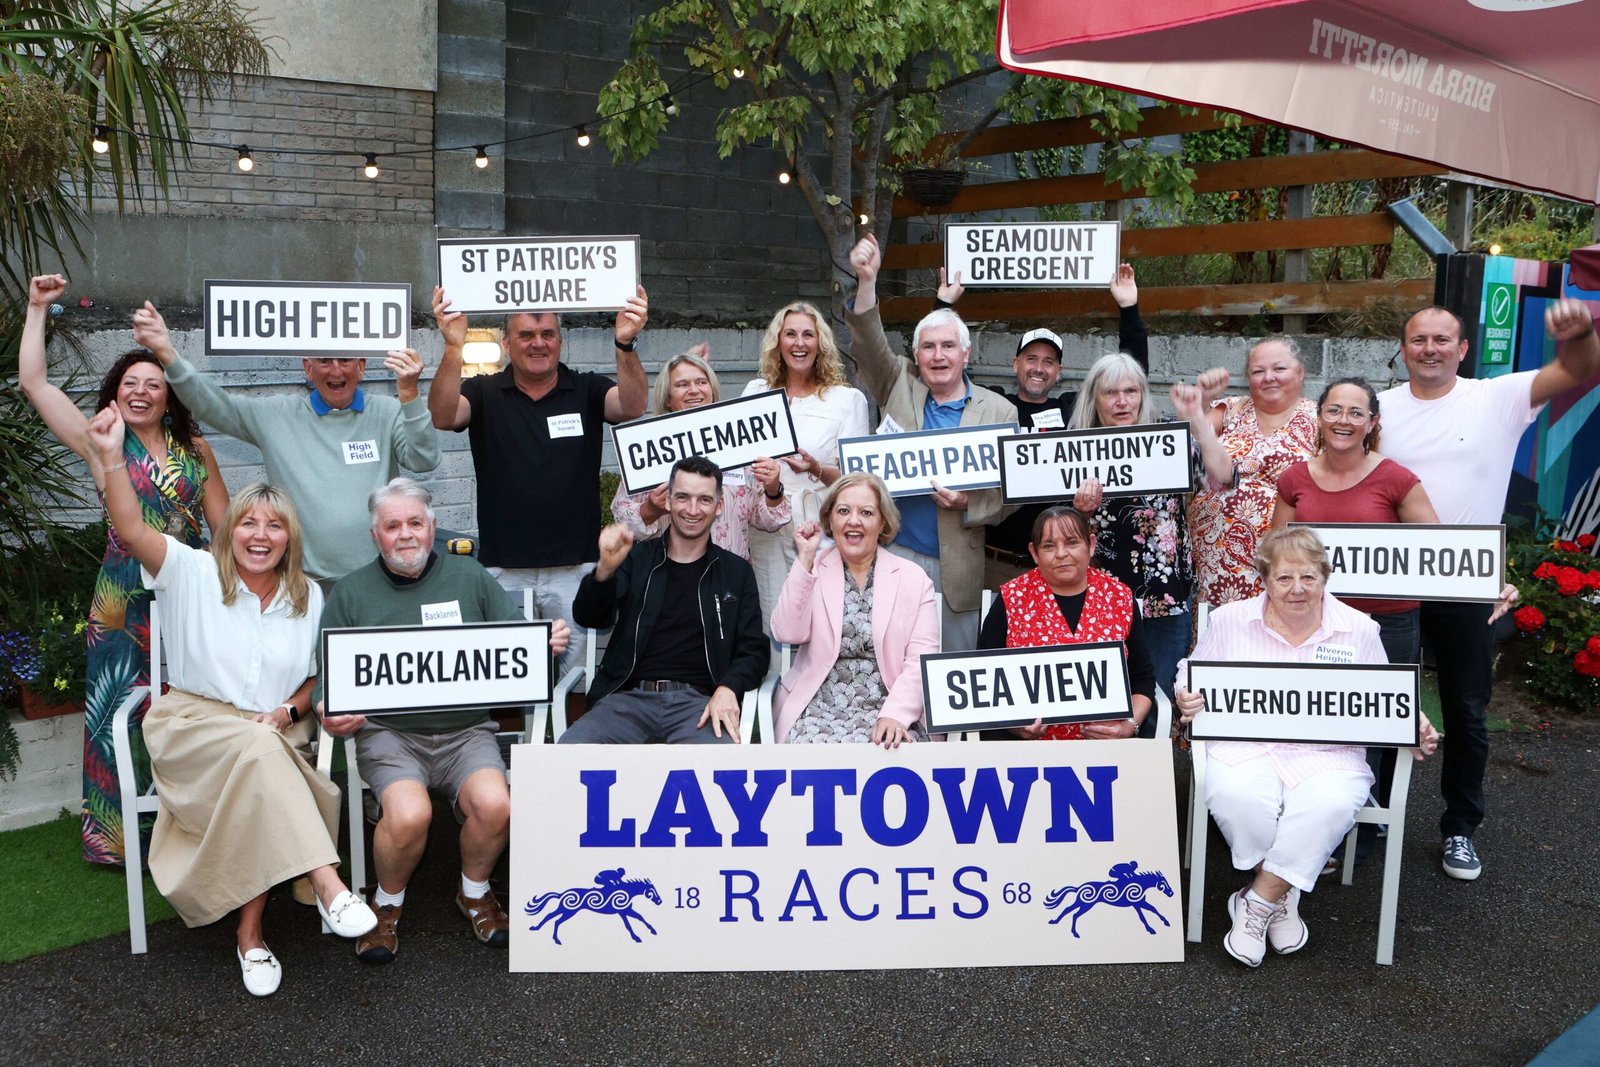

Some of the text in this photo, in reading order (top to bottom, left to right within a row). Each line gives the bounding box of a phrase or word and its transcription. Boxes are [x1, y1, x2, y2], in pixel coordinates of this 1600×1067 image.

[966, 228, 1097, 253] SEAMOUNT
[461, 245, 617, 273] ST PATRICK'S
[970, 256, 1094, 281] CRESCENT
[495, 278, 587, 306] SQUARE
[217, 299, 402, 339] HIGH FIELD
[348, 442, 371, 453] High
[350, 451, 374, 460] Field
[628, 411, 778, 471] CASTLEMARY
[1016, 434, 1176, 466] ST. ANTHONY'S
[847, 443, 999, 481] BEACH PAR
[1323, 546, 1495, 578] ATION ROAD
[354, 646, 528, 687] BACKLANES
[1315, 653, 1352, 663] Heights
[1316, 646, 1353, 657] Alverno
[946, 660, 1108, 710] SEA VIEW
[1307, 691, 1410, 719] HEIGHTS
[579, 765, 1119, 848] LAYTOWN
[674, 865, 1032, 922] 18 RACES 68
